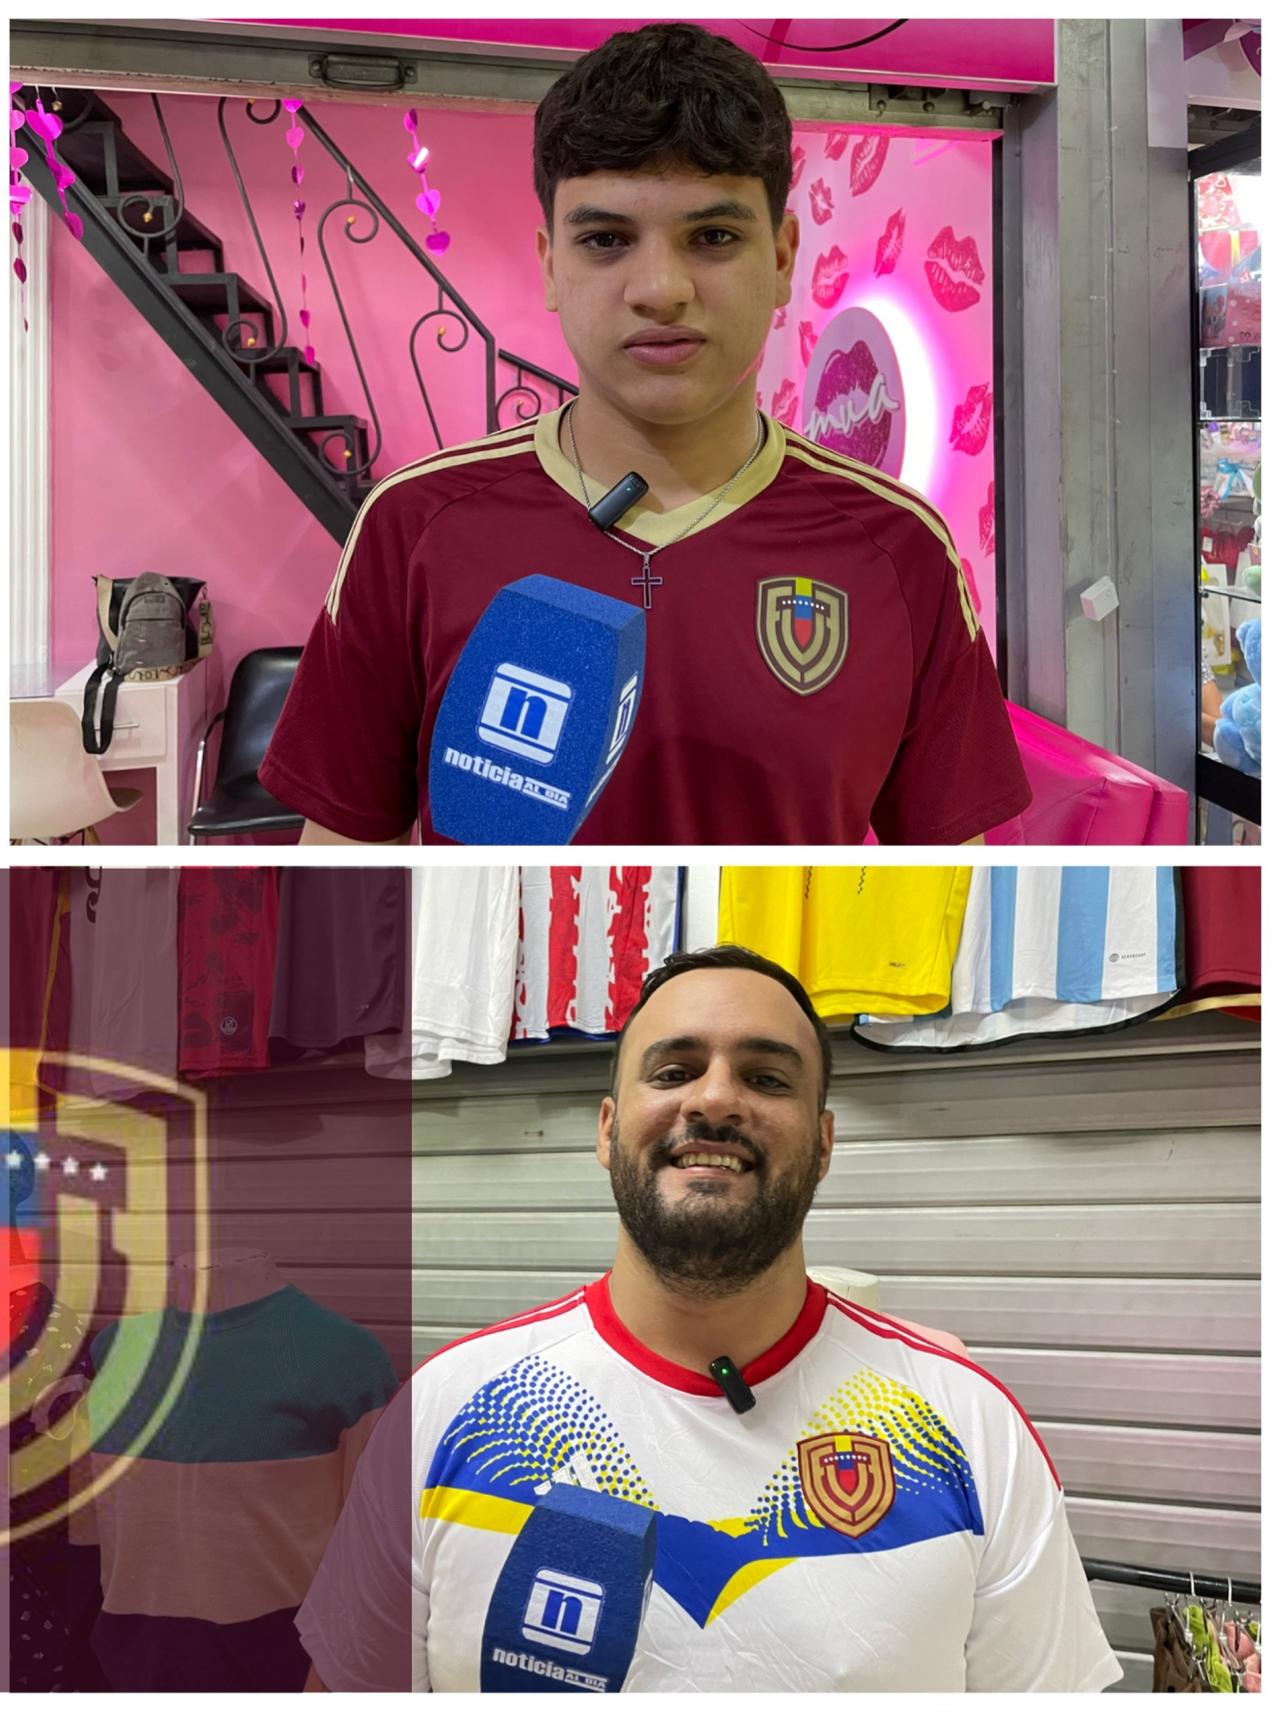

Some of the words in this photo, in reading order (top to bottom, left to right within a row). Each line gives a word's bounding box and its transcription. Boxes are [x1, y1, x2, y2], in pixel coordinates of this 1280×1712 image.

[444, 747, 524, 792] noticia
[525, 782, 541, 794] AL
[545, 789, 569, 804] DIA
[492, 1648, 565, 1681] noticia
